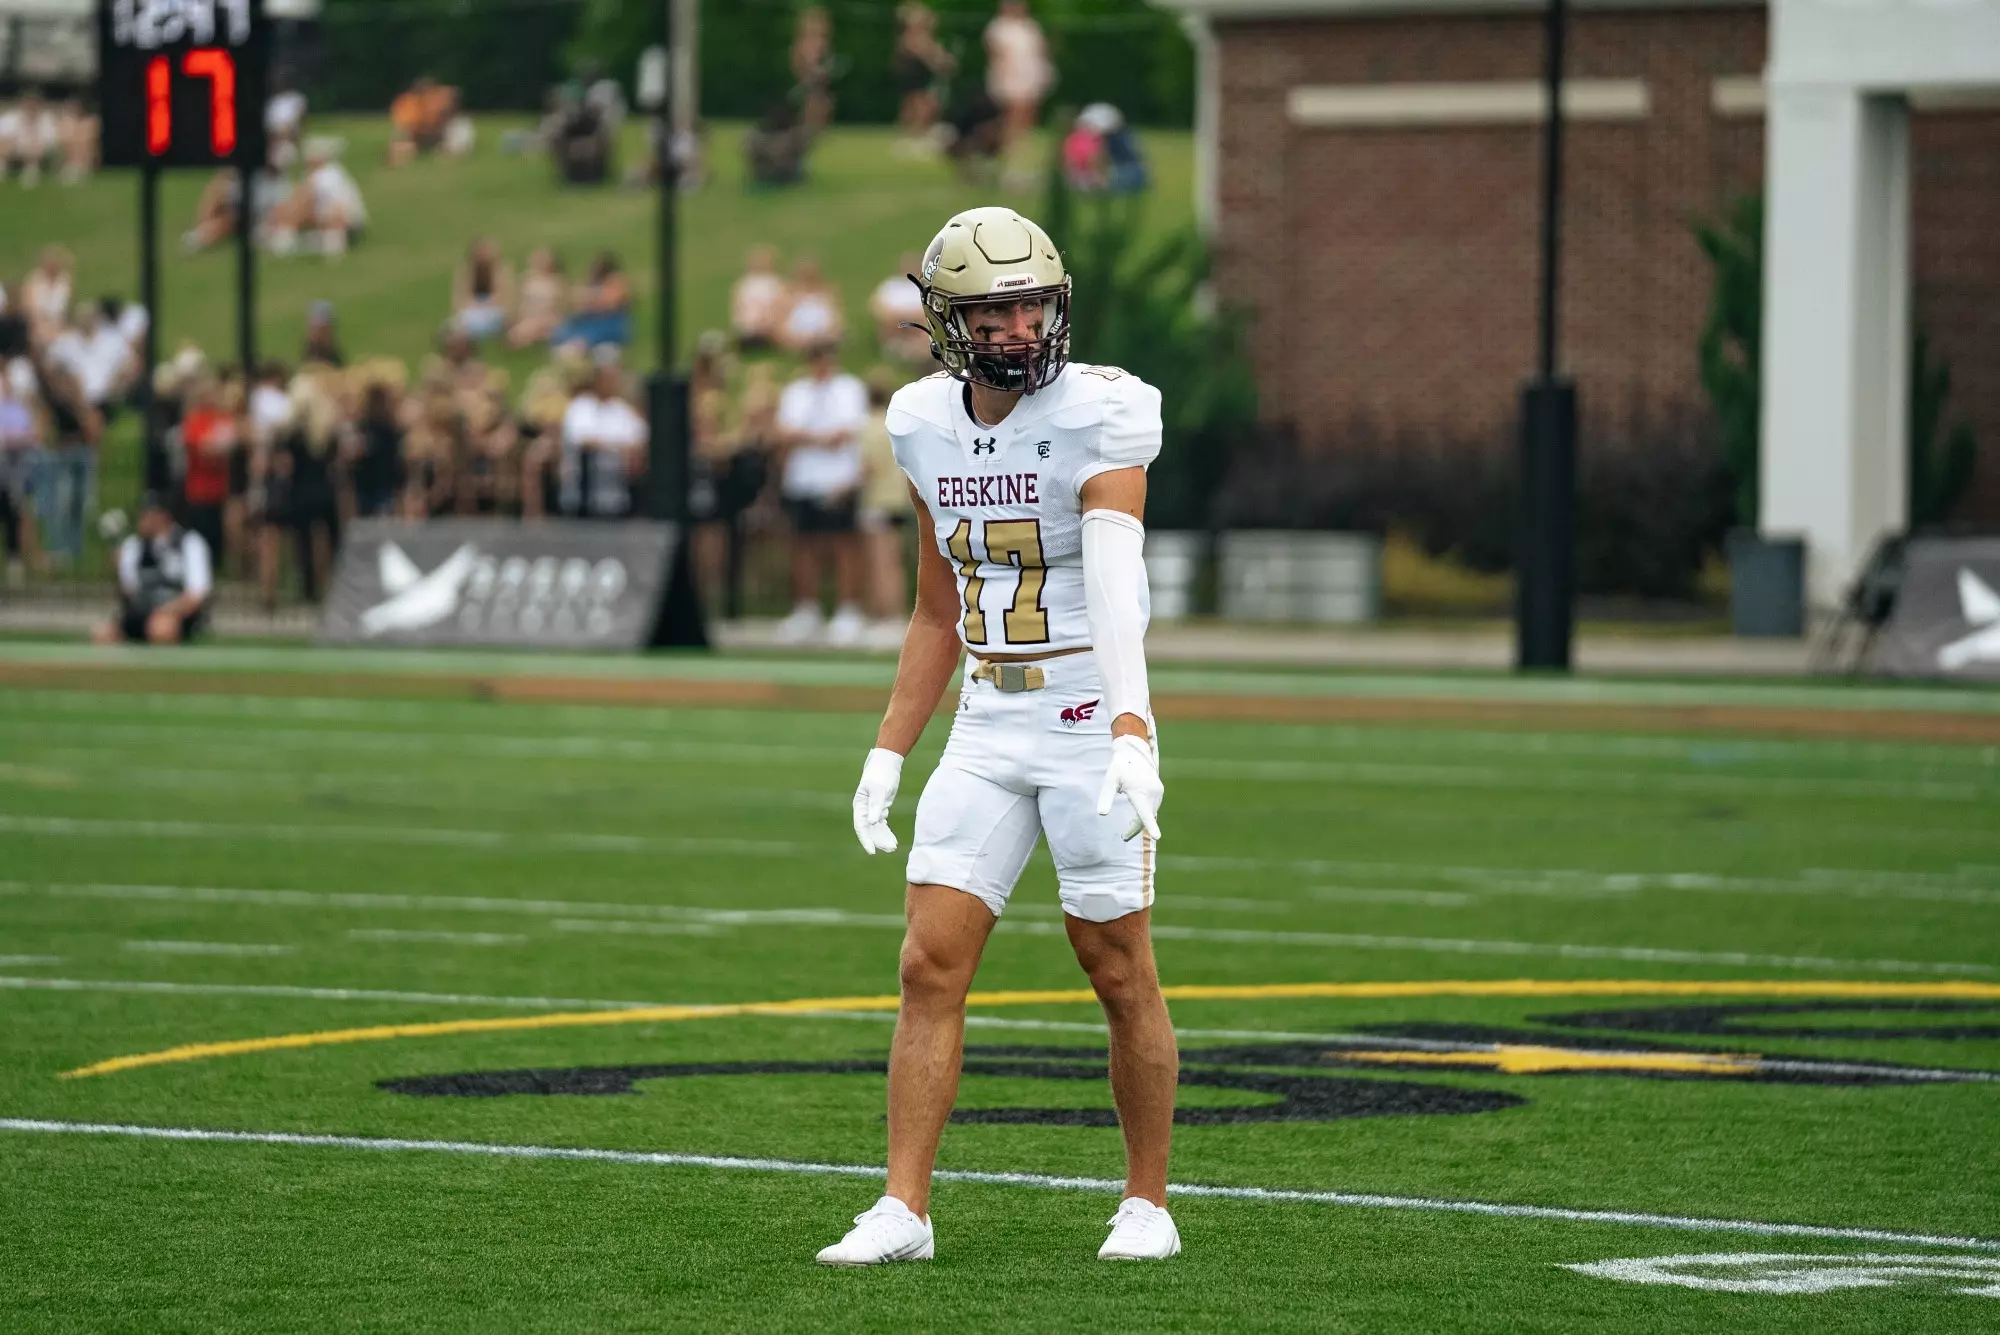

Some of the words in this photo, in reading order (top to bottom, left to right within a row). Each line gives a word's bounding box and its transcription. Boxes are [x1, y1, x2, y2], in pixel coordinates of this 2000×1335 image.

[146, 48, 237, 157] 17
[938, 473, 1039, 507] ERSKINE
[946, 518, 1050, 645] 17
